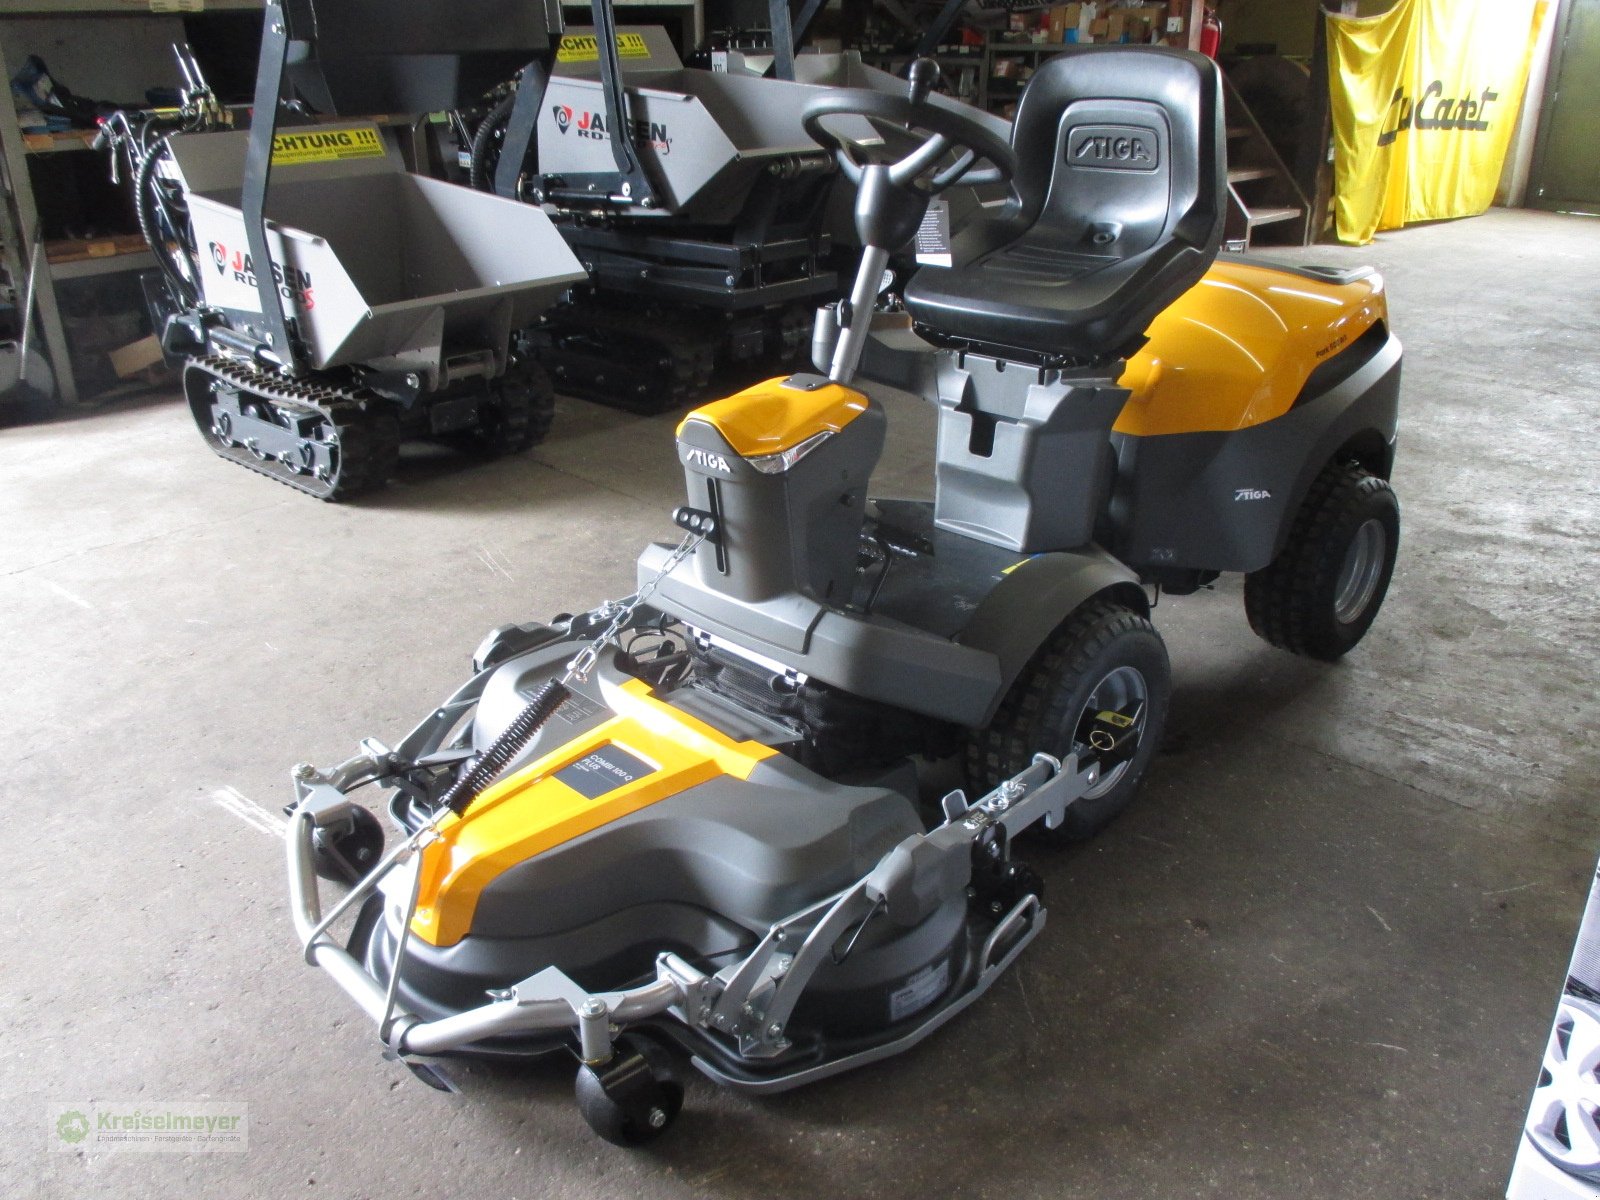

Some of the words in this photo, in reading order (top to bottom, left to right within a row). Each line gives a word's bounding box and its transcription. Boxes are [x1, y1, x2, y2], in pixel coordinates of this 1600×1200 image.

[1414, 80, 1498, 131] Cadet
[1075, 136, 1150, 161] STIGA
[232, 250, 312, 289] JASEN
[686, 449, 731, 473] STIGA
[1235, 488, 1271, 501] STIGA
[581, 758, 601, 770] PLUS
[590, 754, 615, 770] COMBI
